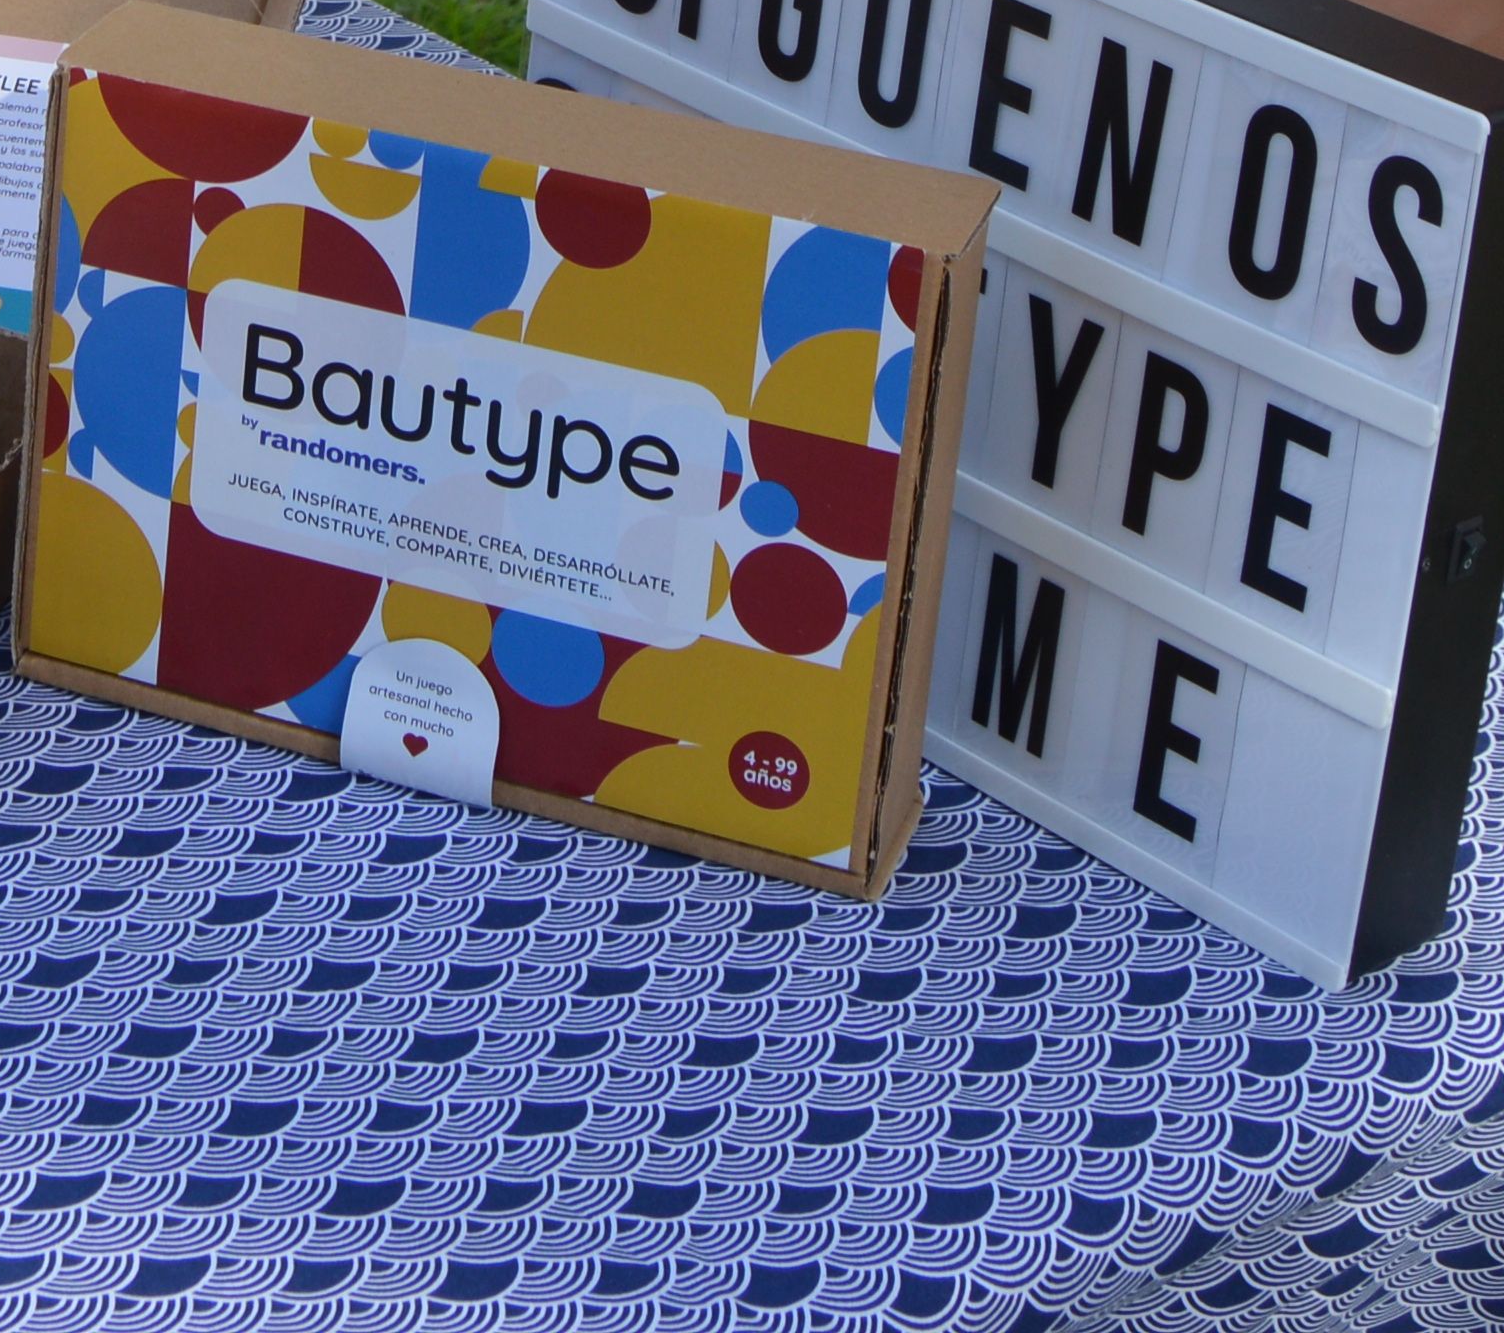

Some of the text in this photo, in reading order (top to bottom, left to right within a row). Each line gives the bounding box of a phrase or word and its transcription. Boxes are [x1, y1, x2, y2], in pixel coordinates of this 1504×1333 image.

[0, 146, 8, 155] y
[10, 145, 27, 157] los
[2, 228, 29, 240] para
[242, 322, 680, 501] Bautype
[241, 414, 426, 485] by randomers.
[1026, 295, 1335, 615] YPE
[228, 472, 675, 598] JUEGA, INSPÍRATE, APRENDE, CREA, DESARRÓLLATE,
[283, 506, 613, 602] CONSTRUYE, COMPARTE, DIVIÉRTETE...
[395, 669, 453, 697] Un juego
[971, 554, 1221, 845] ME
[369, 684, 473, 723] artesanal hecho
[384, 708, 454, 737] con mucho
[743, 750, 757, 767] 4
[775, 757, 798, 776] 99
[743, 767, 792, 793] años
